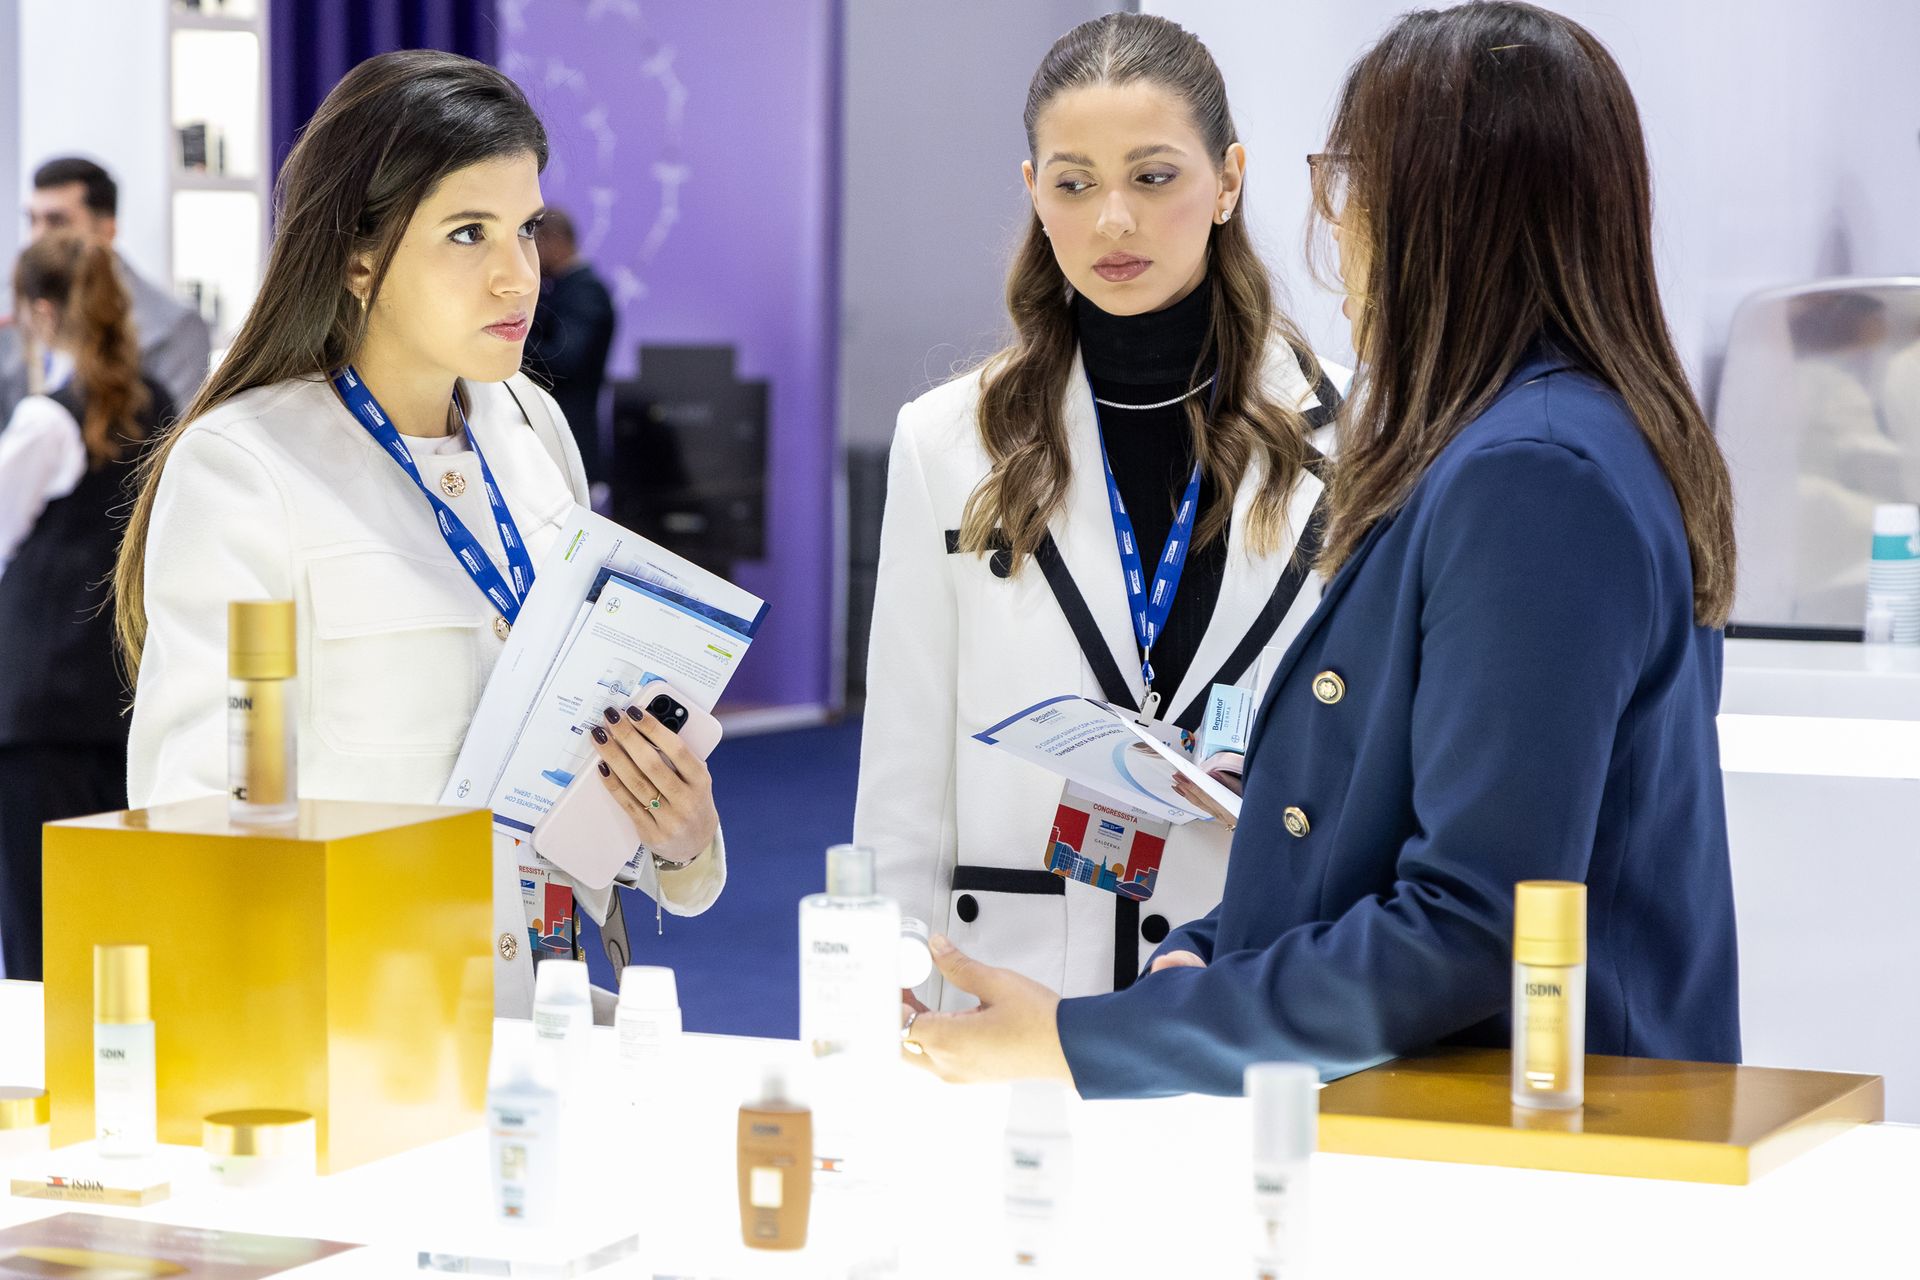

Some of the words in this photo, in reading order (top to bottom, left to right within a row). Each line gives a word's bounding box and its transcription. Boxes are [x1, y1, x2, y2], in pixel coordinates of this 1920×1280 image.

[533, 792, 556, 807] PANTOL
[1093, 803, 1138, 824] CONGRESSISTA
[1094, 838, 1120, 850] GALDERMA
[518, 865, 545, 877] RESSISTA
[1525, 983, 1562, 997] ISDIN
[72, 1178, 104, 1192] ISDIN
